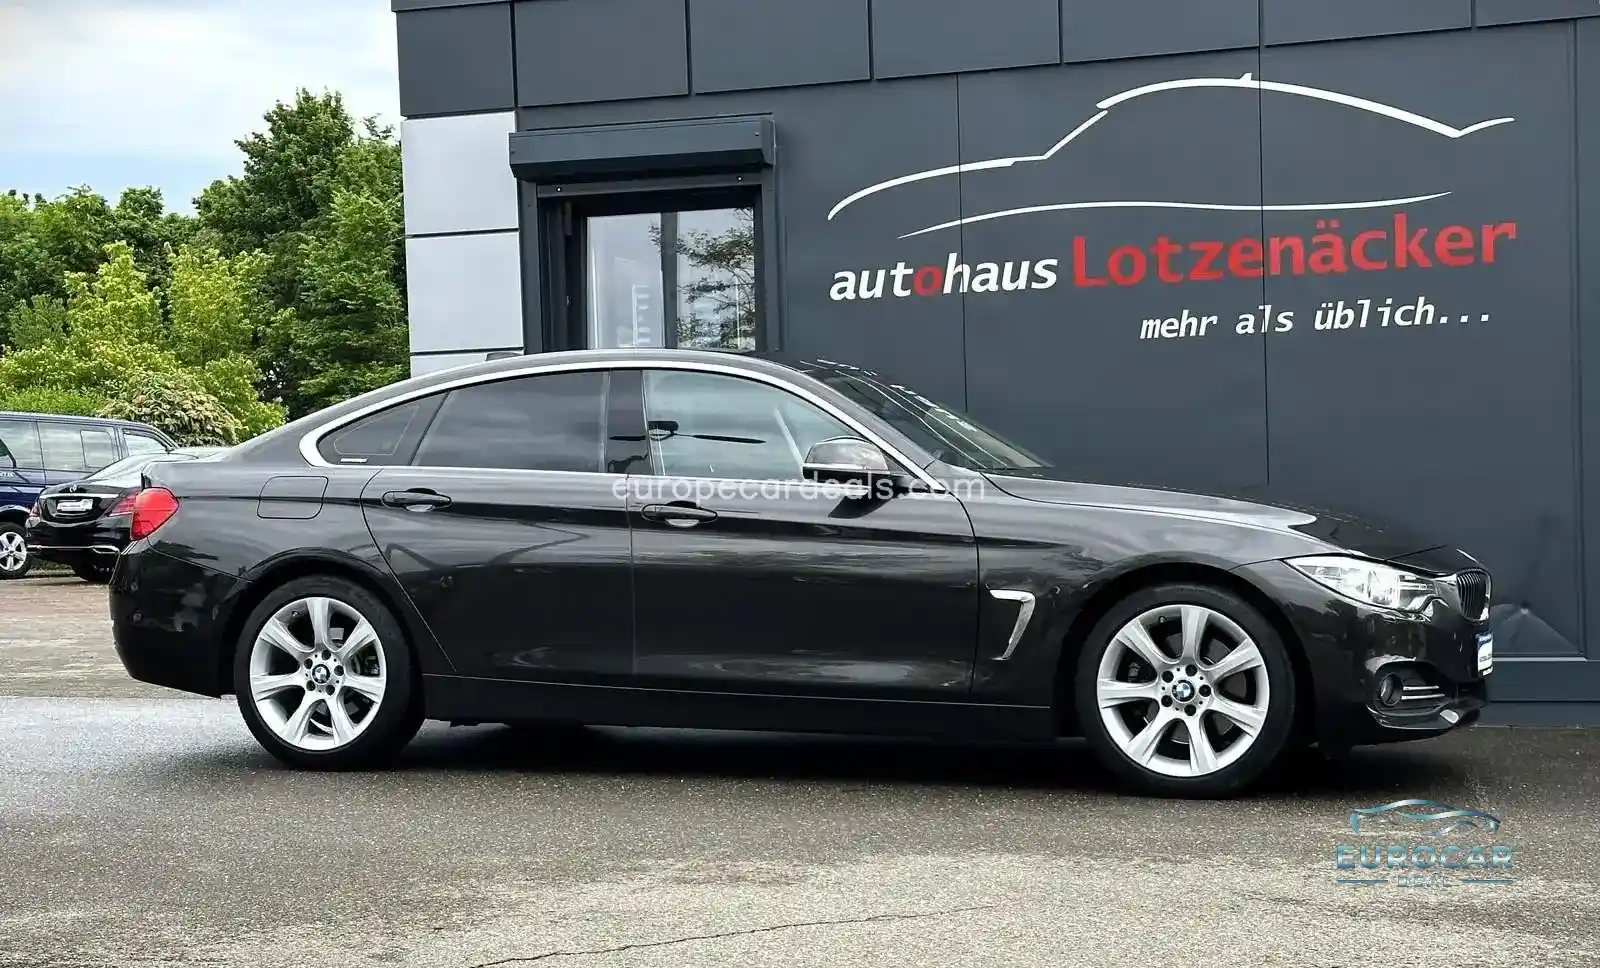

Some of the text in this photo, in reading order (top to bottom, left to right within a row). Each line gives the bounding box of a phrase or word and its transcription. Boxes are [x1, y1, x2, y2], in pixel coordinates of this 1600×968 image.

[829, 212, 1517, 301] autohaus Lotzenäcker
[1140, 296, 1490, 340] mehr als üblich...
